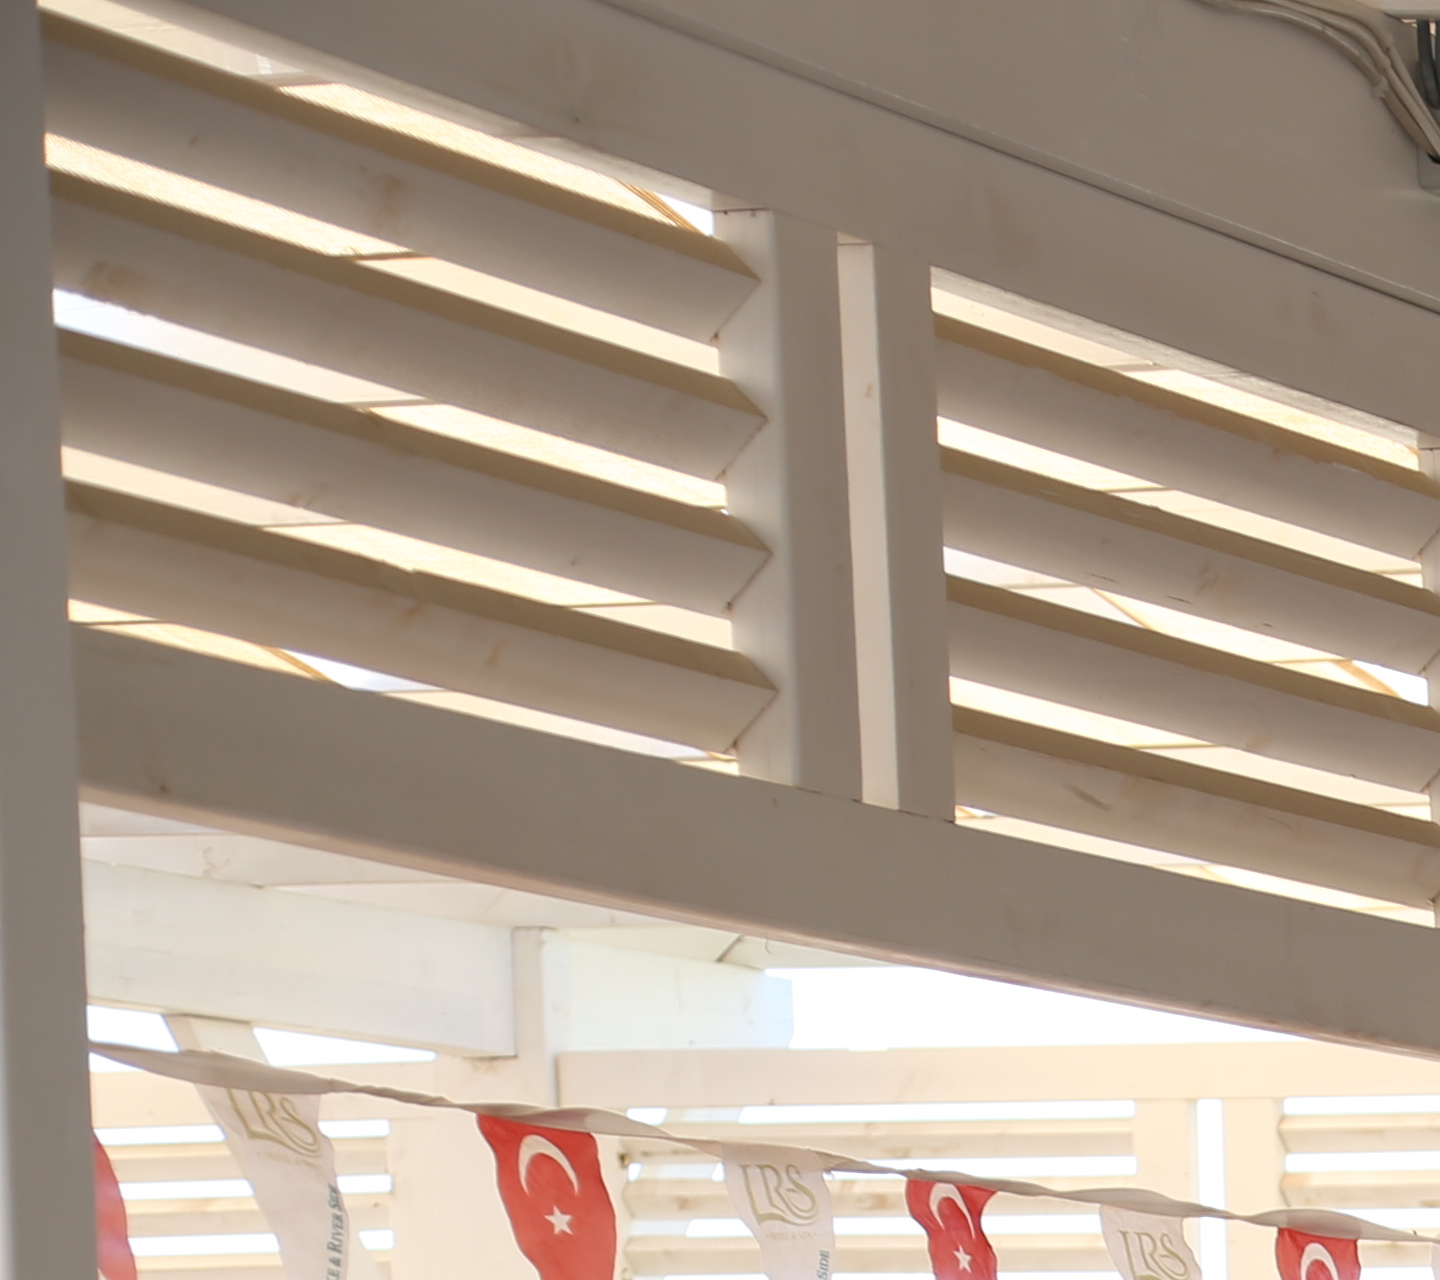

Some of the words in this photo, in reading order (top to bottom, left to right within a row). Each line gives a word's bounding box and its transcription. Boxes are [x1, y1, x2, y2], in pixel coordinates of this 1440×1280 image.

[738, 1163, 819, 1227] LRS
[326, 1213, 344, 1255] RIVER
[328, 1254, 342, 1268] &
